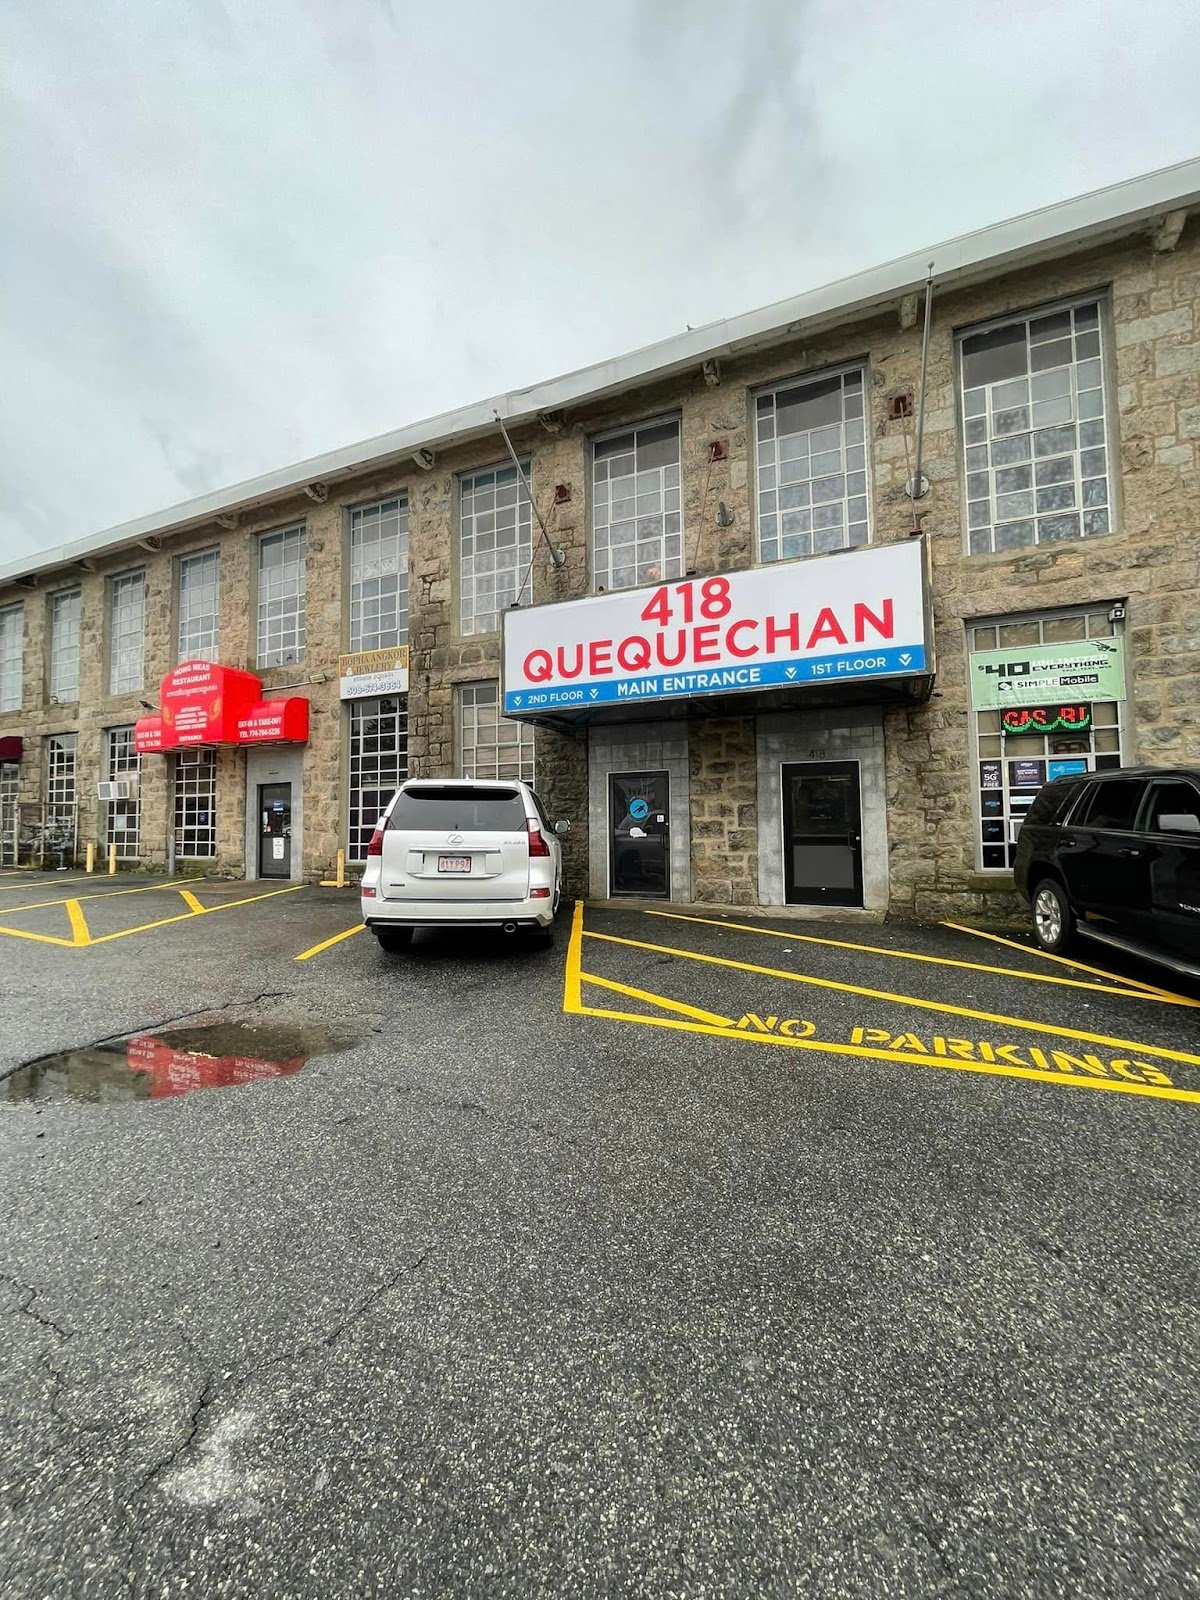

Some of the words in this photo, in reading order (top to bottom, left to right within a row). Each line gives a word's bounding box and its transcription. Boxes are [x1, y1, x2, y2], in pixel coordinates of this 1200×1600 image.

[640, 577, 732, 627] 418
[522, 598, 895, 683] QUEQUECHAN
[371, 650, 406, 661] ANGKOR
[811, 661, 835, 676] 1ST
[836, 656, 887, 674] FLOOR
[1032, 659, 1110, 672] EVERYTHING
[172, 673, 211, 686] RESTAURANT
[617, 678, 658, 697] MAIN
[662, 667, 761, 694] ENTRANCE
[1017, 678, 1060, 688] SIMPLE
[1060, 674, 1098, 686] Mobile
[527, 691, 549, 704] 2ND
[550, 689, 584, 703] FLOOR
[983, 773, 998, 781] 5G
[736, 1012, 818, 1038] NO
[850, 1026, 1175, 1087] PARKING
